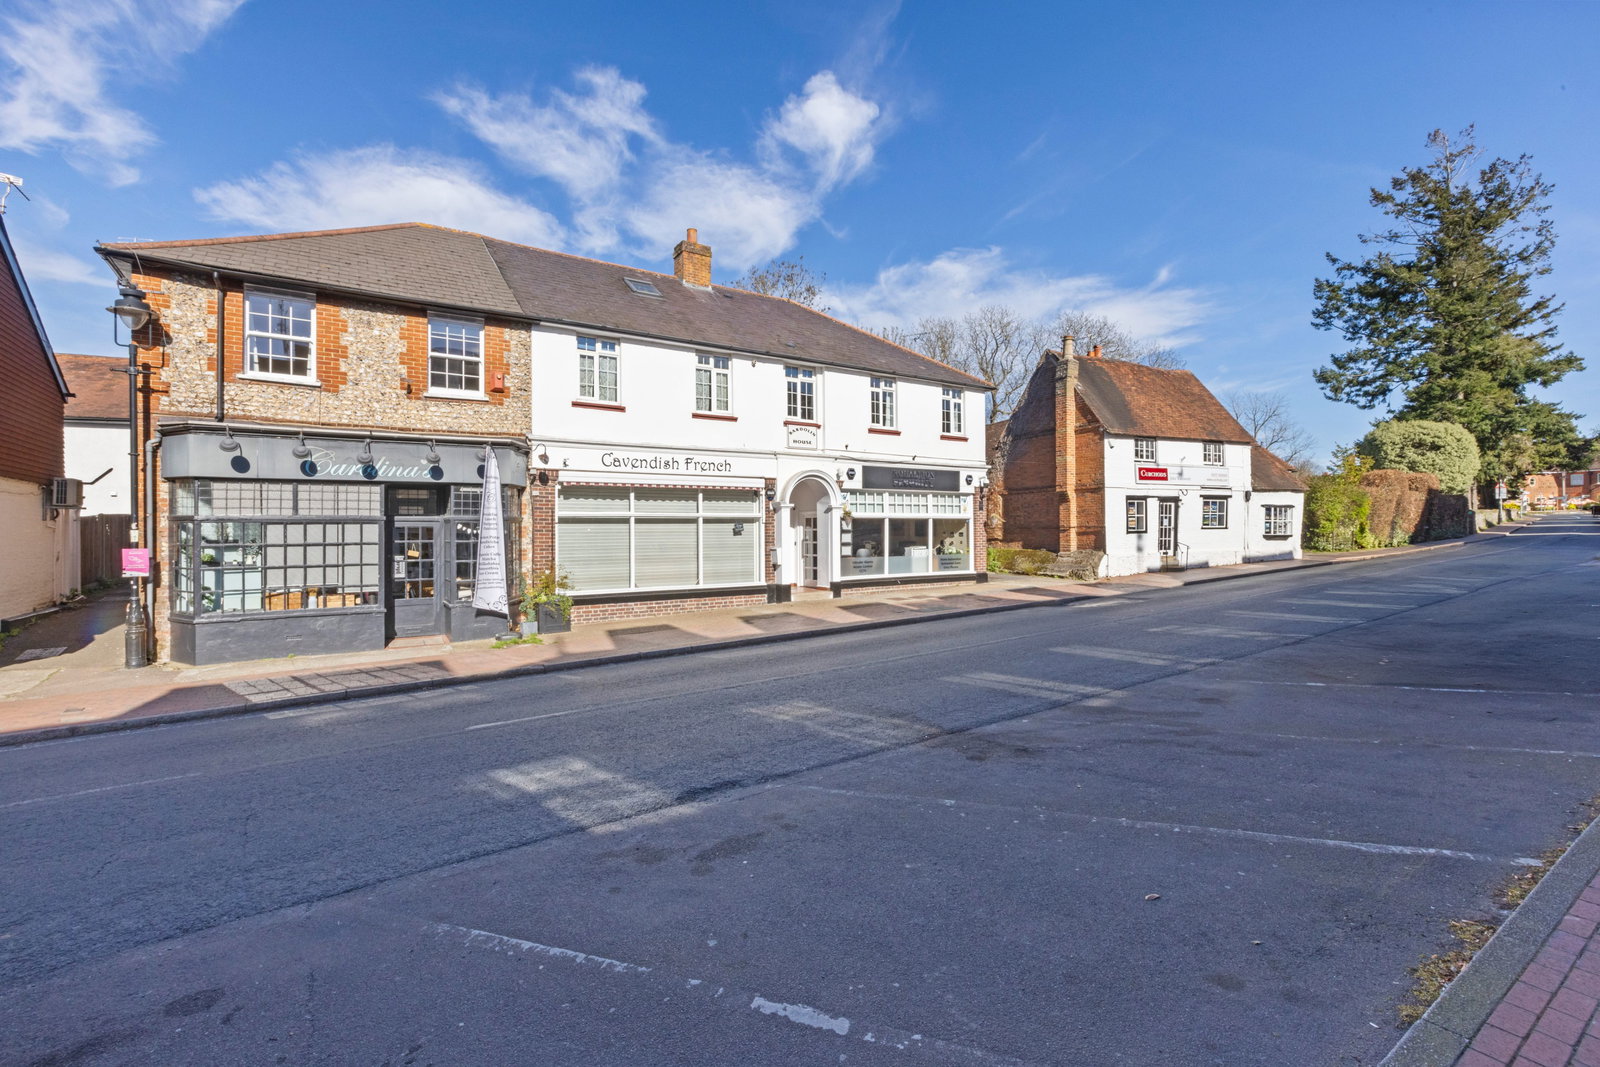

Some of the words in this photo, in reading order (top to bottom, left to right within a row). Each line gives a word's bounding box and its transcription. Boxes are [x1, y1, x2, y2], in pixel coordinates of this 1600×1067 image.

[305, 446, 433, 479] Carolina's
[601, 452, 680, 470] Cavendish
[684, 457, 732, 473] French
